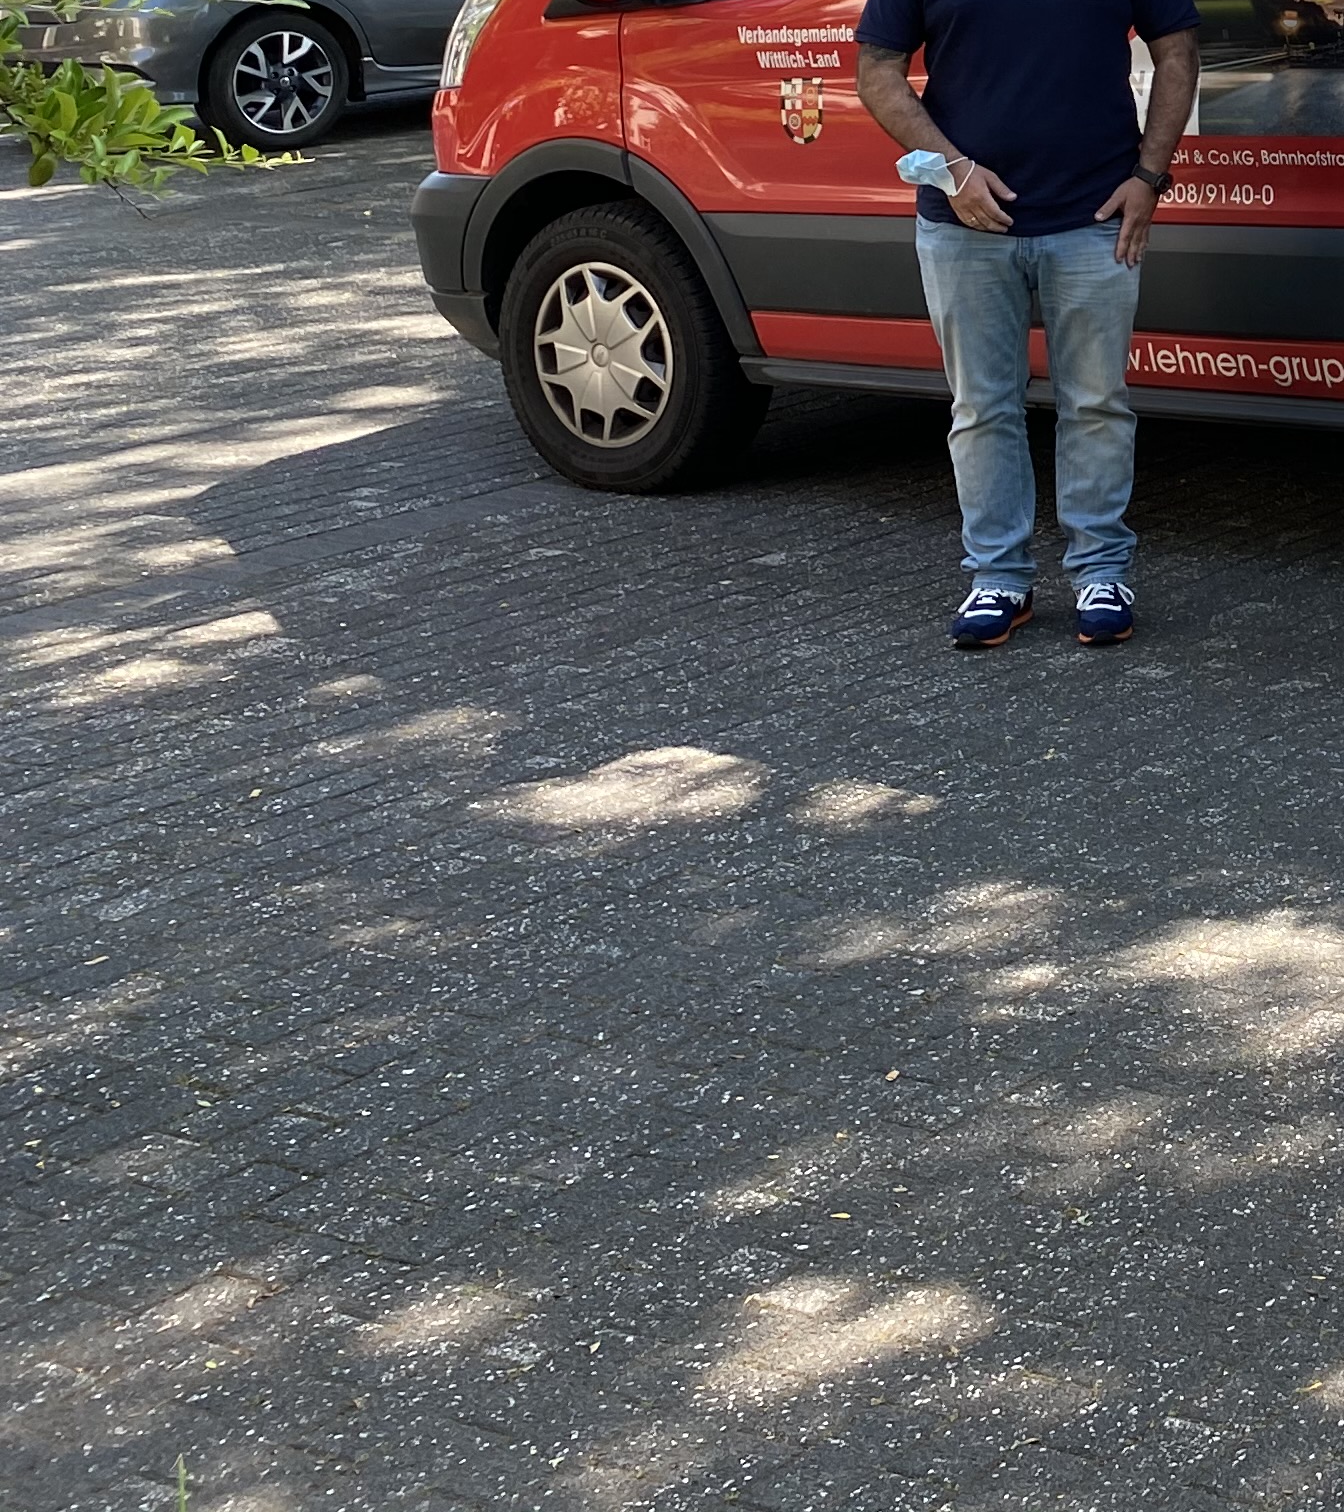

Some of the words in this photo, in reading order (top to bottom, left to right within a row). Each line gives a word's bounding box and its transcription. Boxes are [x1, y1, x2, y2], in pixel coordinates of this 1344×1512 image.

[737, 24, 854, 46] Verbandsgemeinde
[756, 50, 841, 69] Wittlich-Land
[1194, 150, 1205, 164] &
